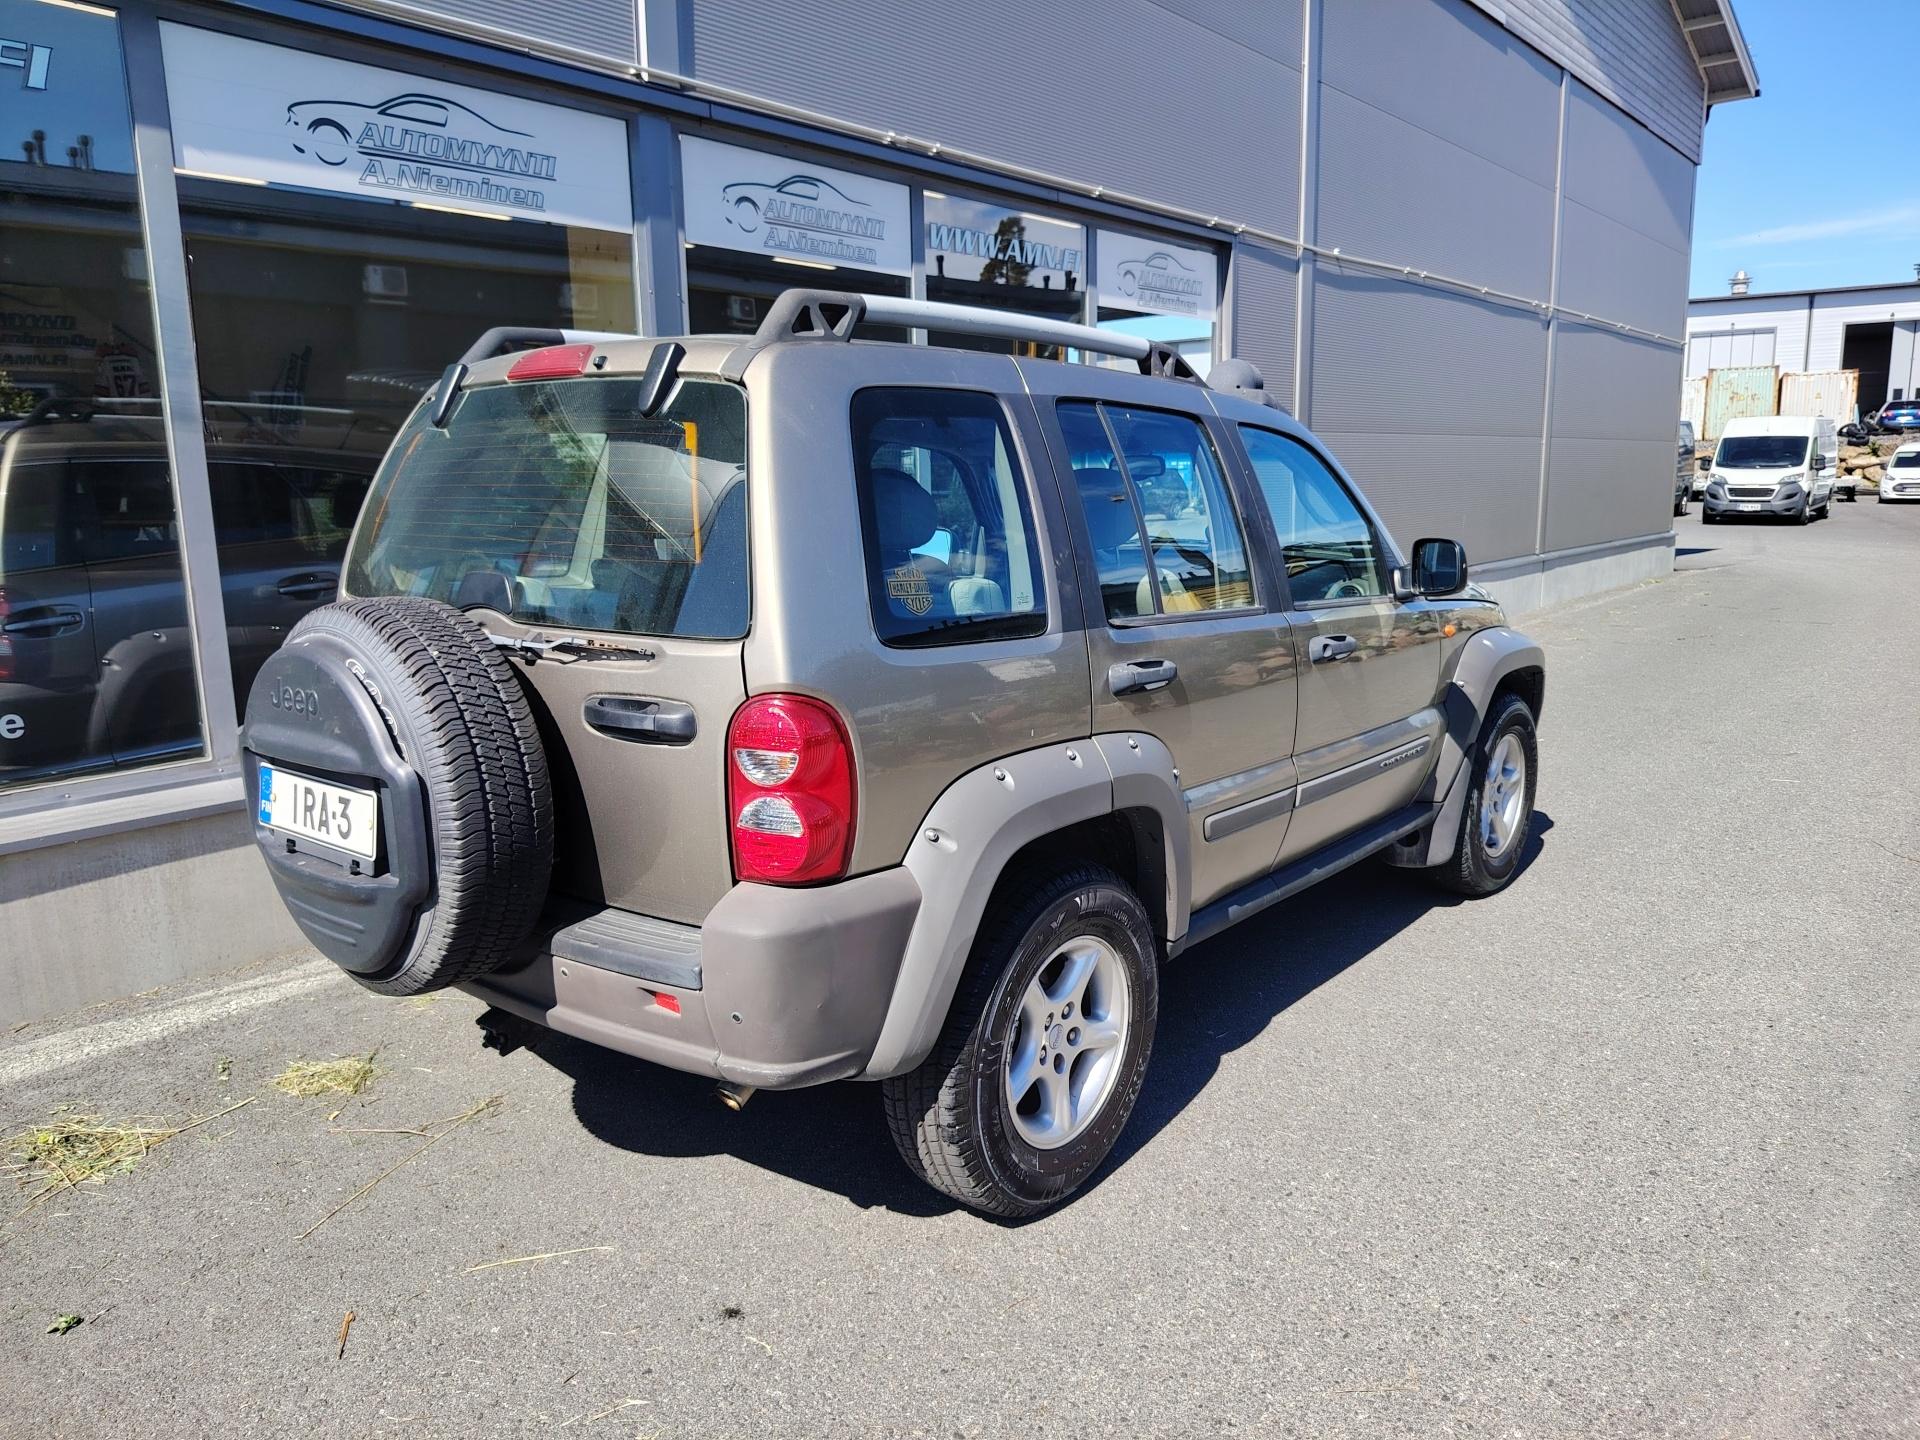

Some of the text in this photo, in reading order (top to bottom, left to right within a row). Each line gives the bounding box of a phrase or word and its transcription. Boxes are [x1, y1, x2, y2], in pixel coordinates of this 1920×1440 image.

[356, 122, 557, 177] AUTOMYYNTI
[361, 159, 546, 208] A.Nieminen
[763, 198, 885, 238] AUTOMYYNTI
[764, 227, 877, 262] A.Nieminen
[929, 222, 1081, 273] WWW.AMN.FI
[271, 677, 319, 720] Jeep
[292, 783, 353, 840] IRA-3
